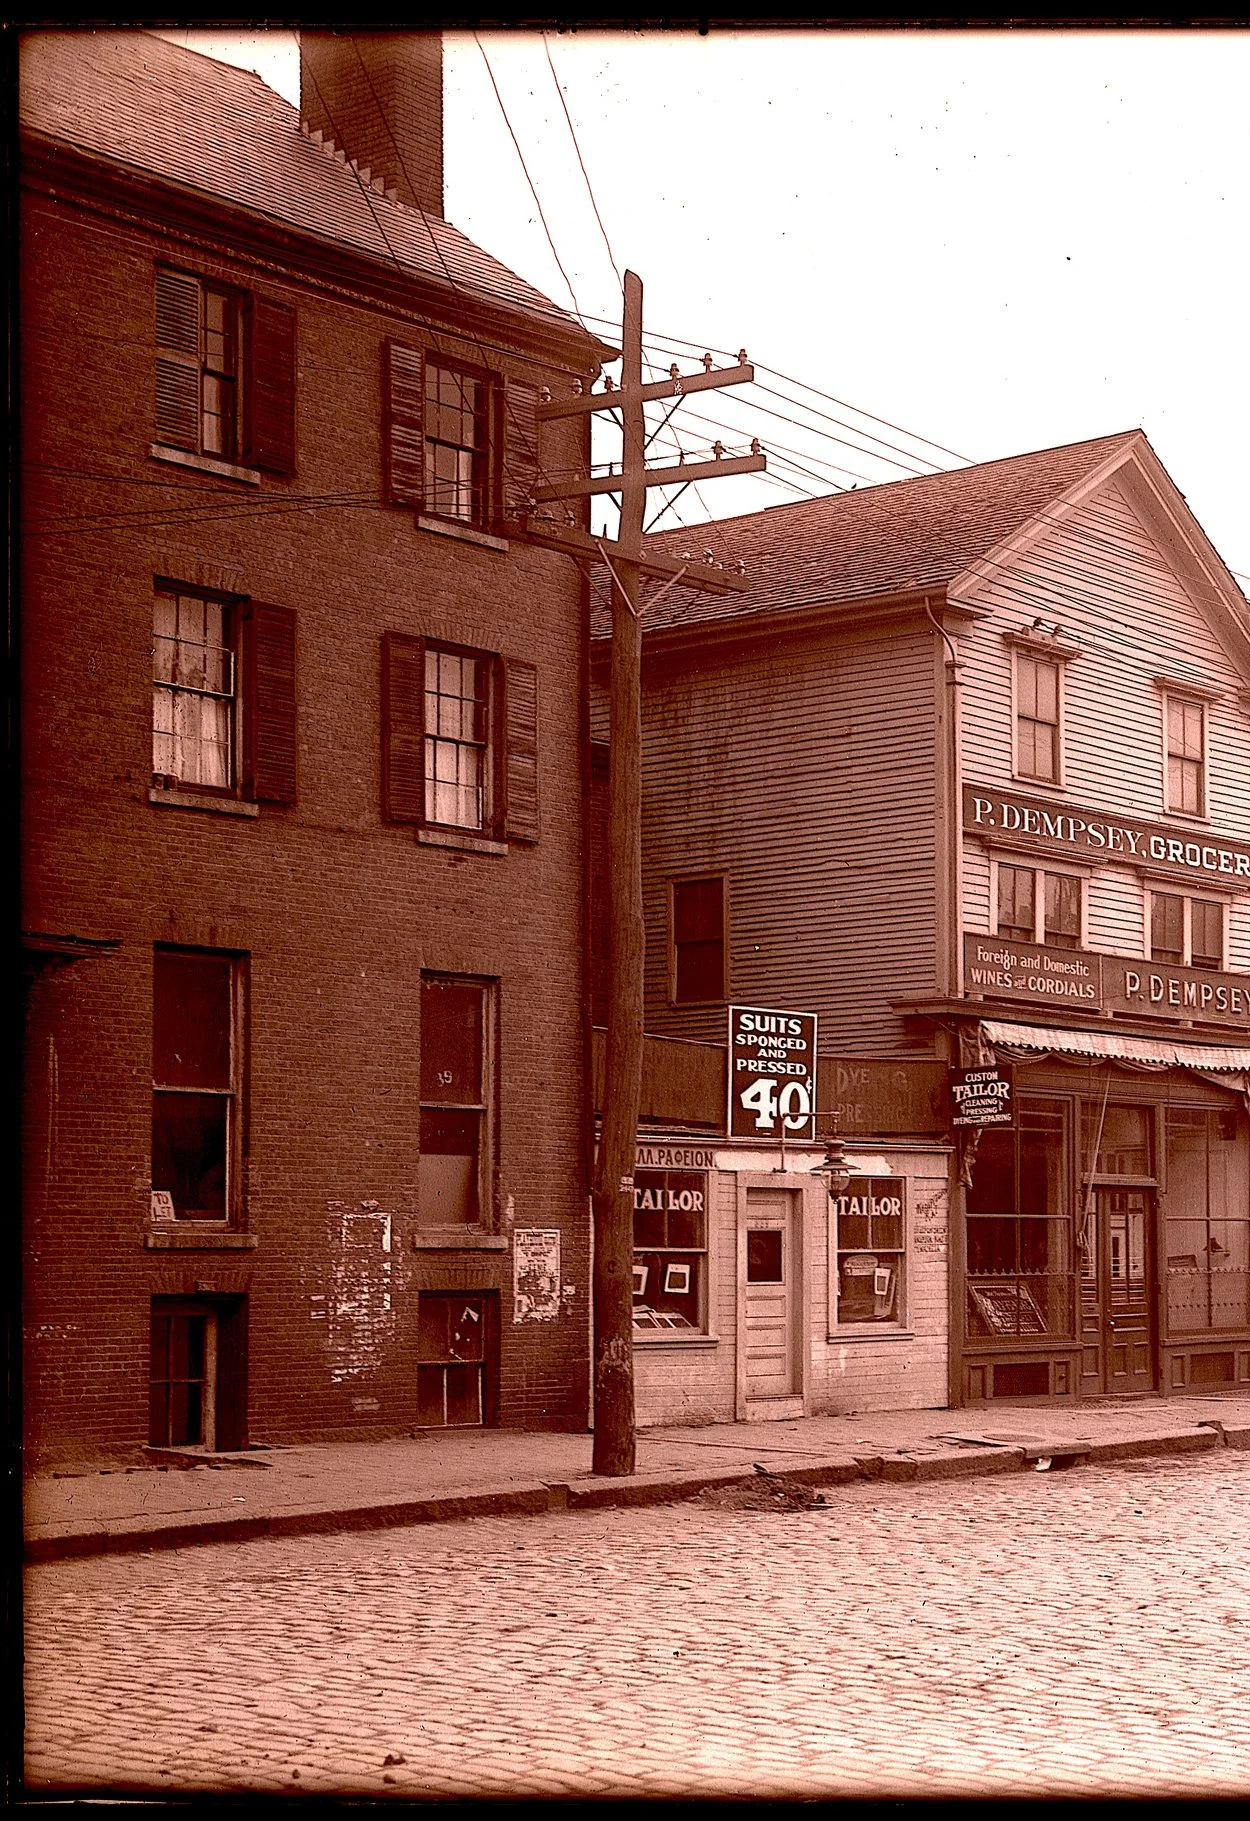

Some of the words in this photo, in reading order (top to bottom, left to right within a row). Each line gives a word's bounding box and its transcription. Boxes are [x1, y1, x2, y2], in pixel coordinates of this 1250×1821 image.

[972, 797, 996, 825] P.
[1000, 803, 1148, 858] DEMPSEY,
[976, 945, 1018, 971] Foreign
[1020, 955, 1041, 970] and
[1043, 956, 1090, 977] Domestic
[970, 967, 1013, 989] WINES
[1028, 976, 1095, 999] CORDIALS
[1125, 971, 1144, 1000] P.
[739, 1014, 802, 1035] SUITS
[735, 1033, 807, 1051] SPONGED
[757, 1049, 787, 1059] AND
[736, 1059, 807, 1076] PRESSED
[952, 1082, 1010, 1103] TAILOR
[965, 1097, 998, 1107] CLEANING
[965, 1107, 998, 1115] PRESSING
[153, 1192, 169, 1205] TO
[634, 1188, 704, 1212] TAILOR
[838, 1195, 902, 1217] TAILOR
